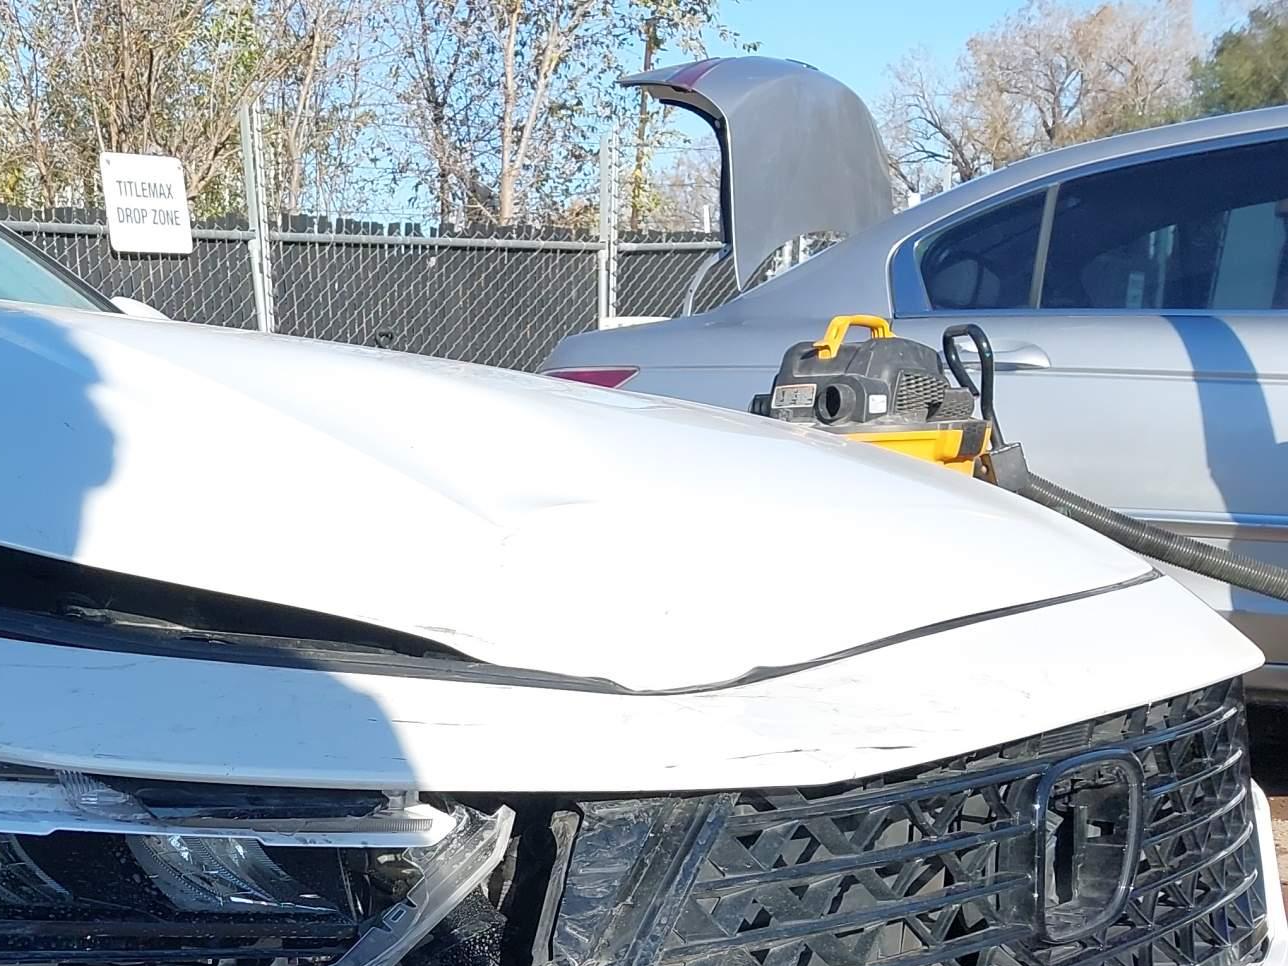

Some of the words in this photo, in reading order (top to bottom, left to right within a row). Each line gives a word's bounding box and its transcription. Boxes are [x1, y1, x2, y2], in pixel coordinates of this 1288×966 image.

[115, 180, 174, 200] TITLEMAX
[116, 207, 148, 225] DROP
[151, 208, 181, 226] ZONE
